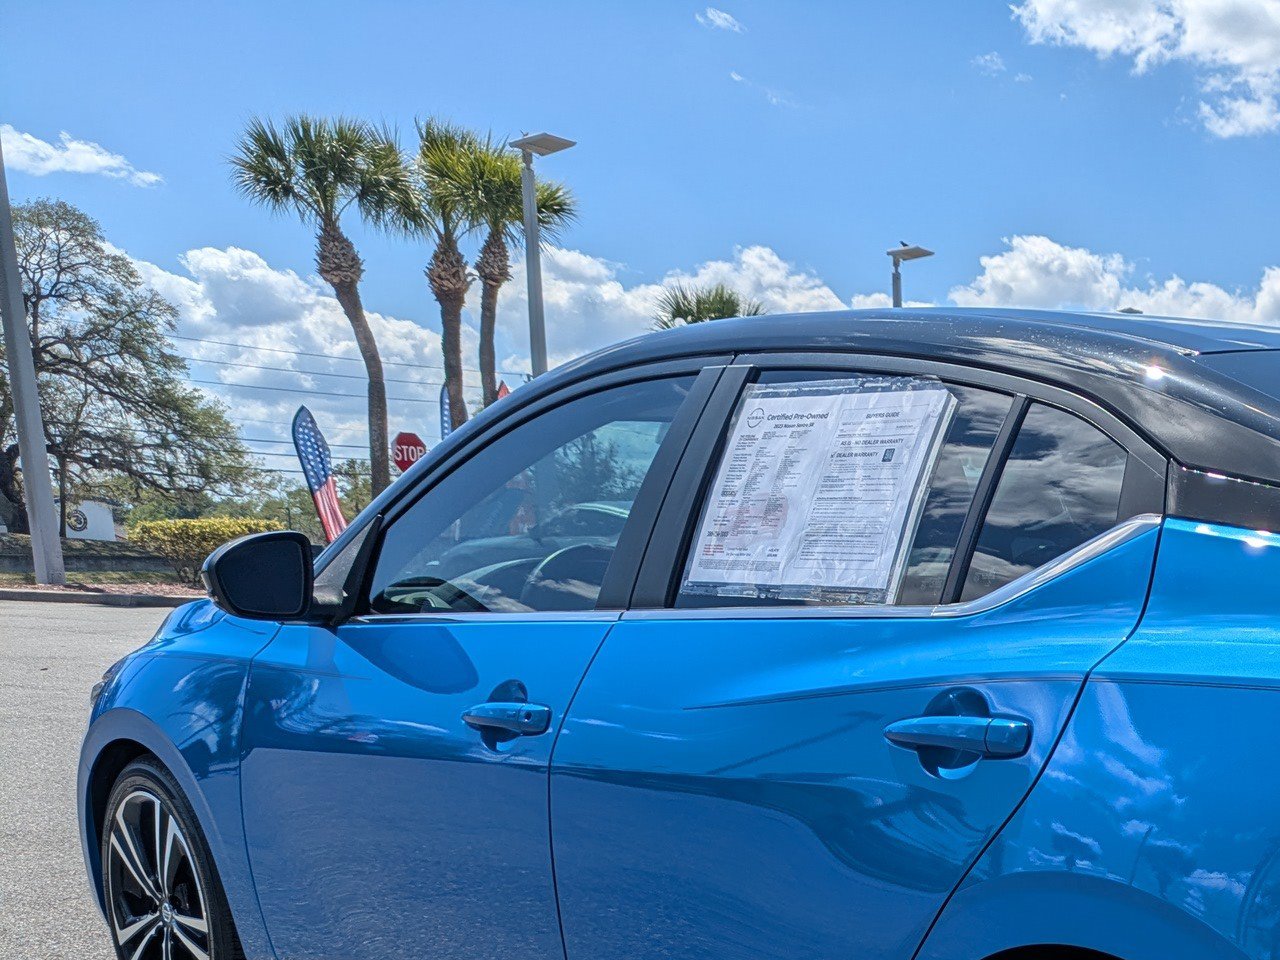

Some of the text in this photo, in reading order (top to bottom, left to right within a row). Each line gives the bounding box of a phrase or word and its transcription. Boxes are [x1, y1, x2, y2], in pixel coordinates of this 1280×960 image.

[767, 411, 830, 421] Certified Pre-Owned
[394, 445, 425, 462] STOP
